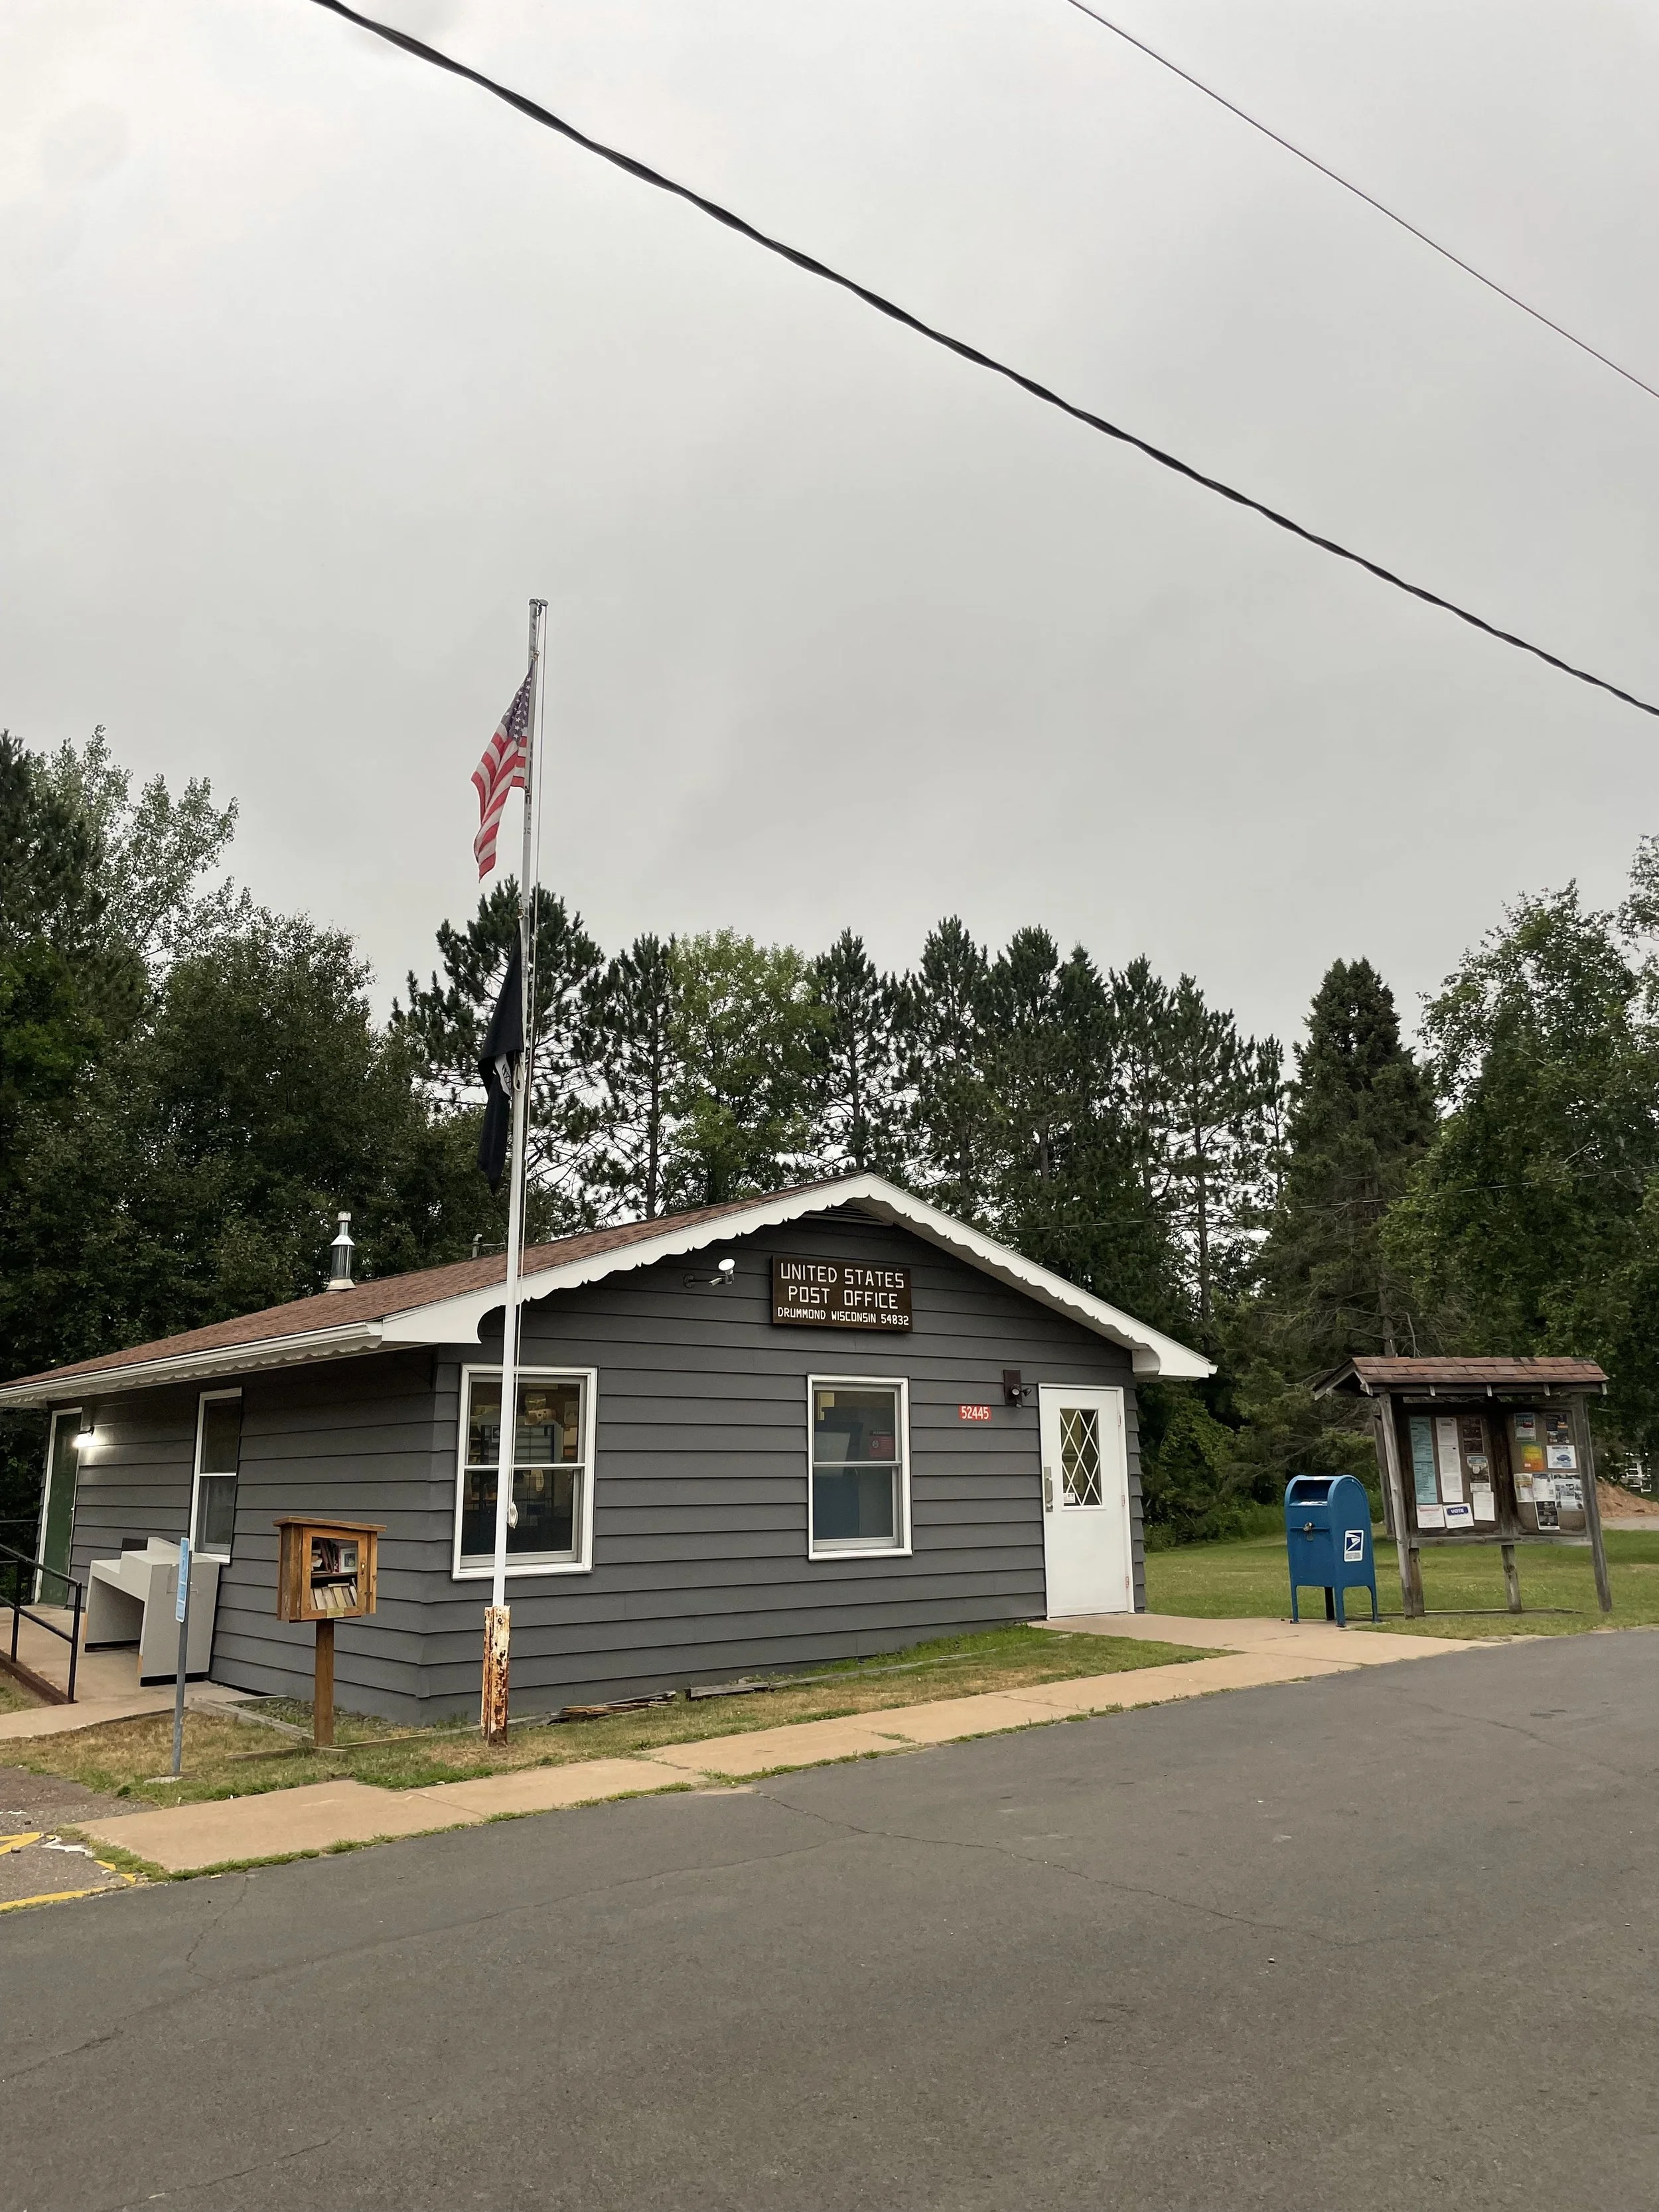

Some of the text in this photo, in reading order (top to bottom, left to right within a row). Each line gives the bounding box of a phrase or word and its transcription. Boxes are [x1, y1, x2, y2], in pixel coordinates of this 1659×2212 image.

[780, 1262, 904, 1289] UNITED STATES
[788, 1286, 899, 1309] POST OFFICE
[777, 1307, 909, 1325] DRUMMOND WISCONSIN 54832
[961, 1406, 989, 1420] 52445
